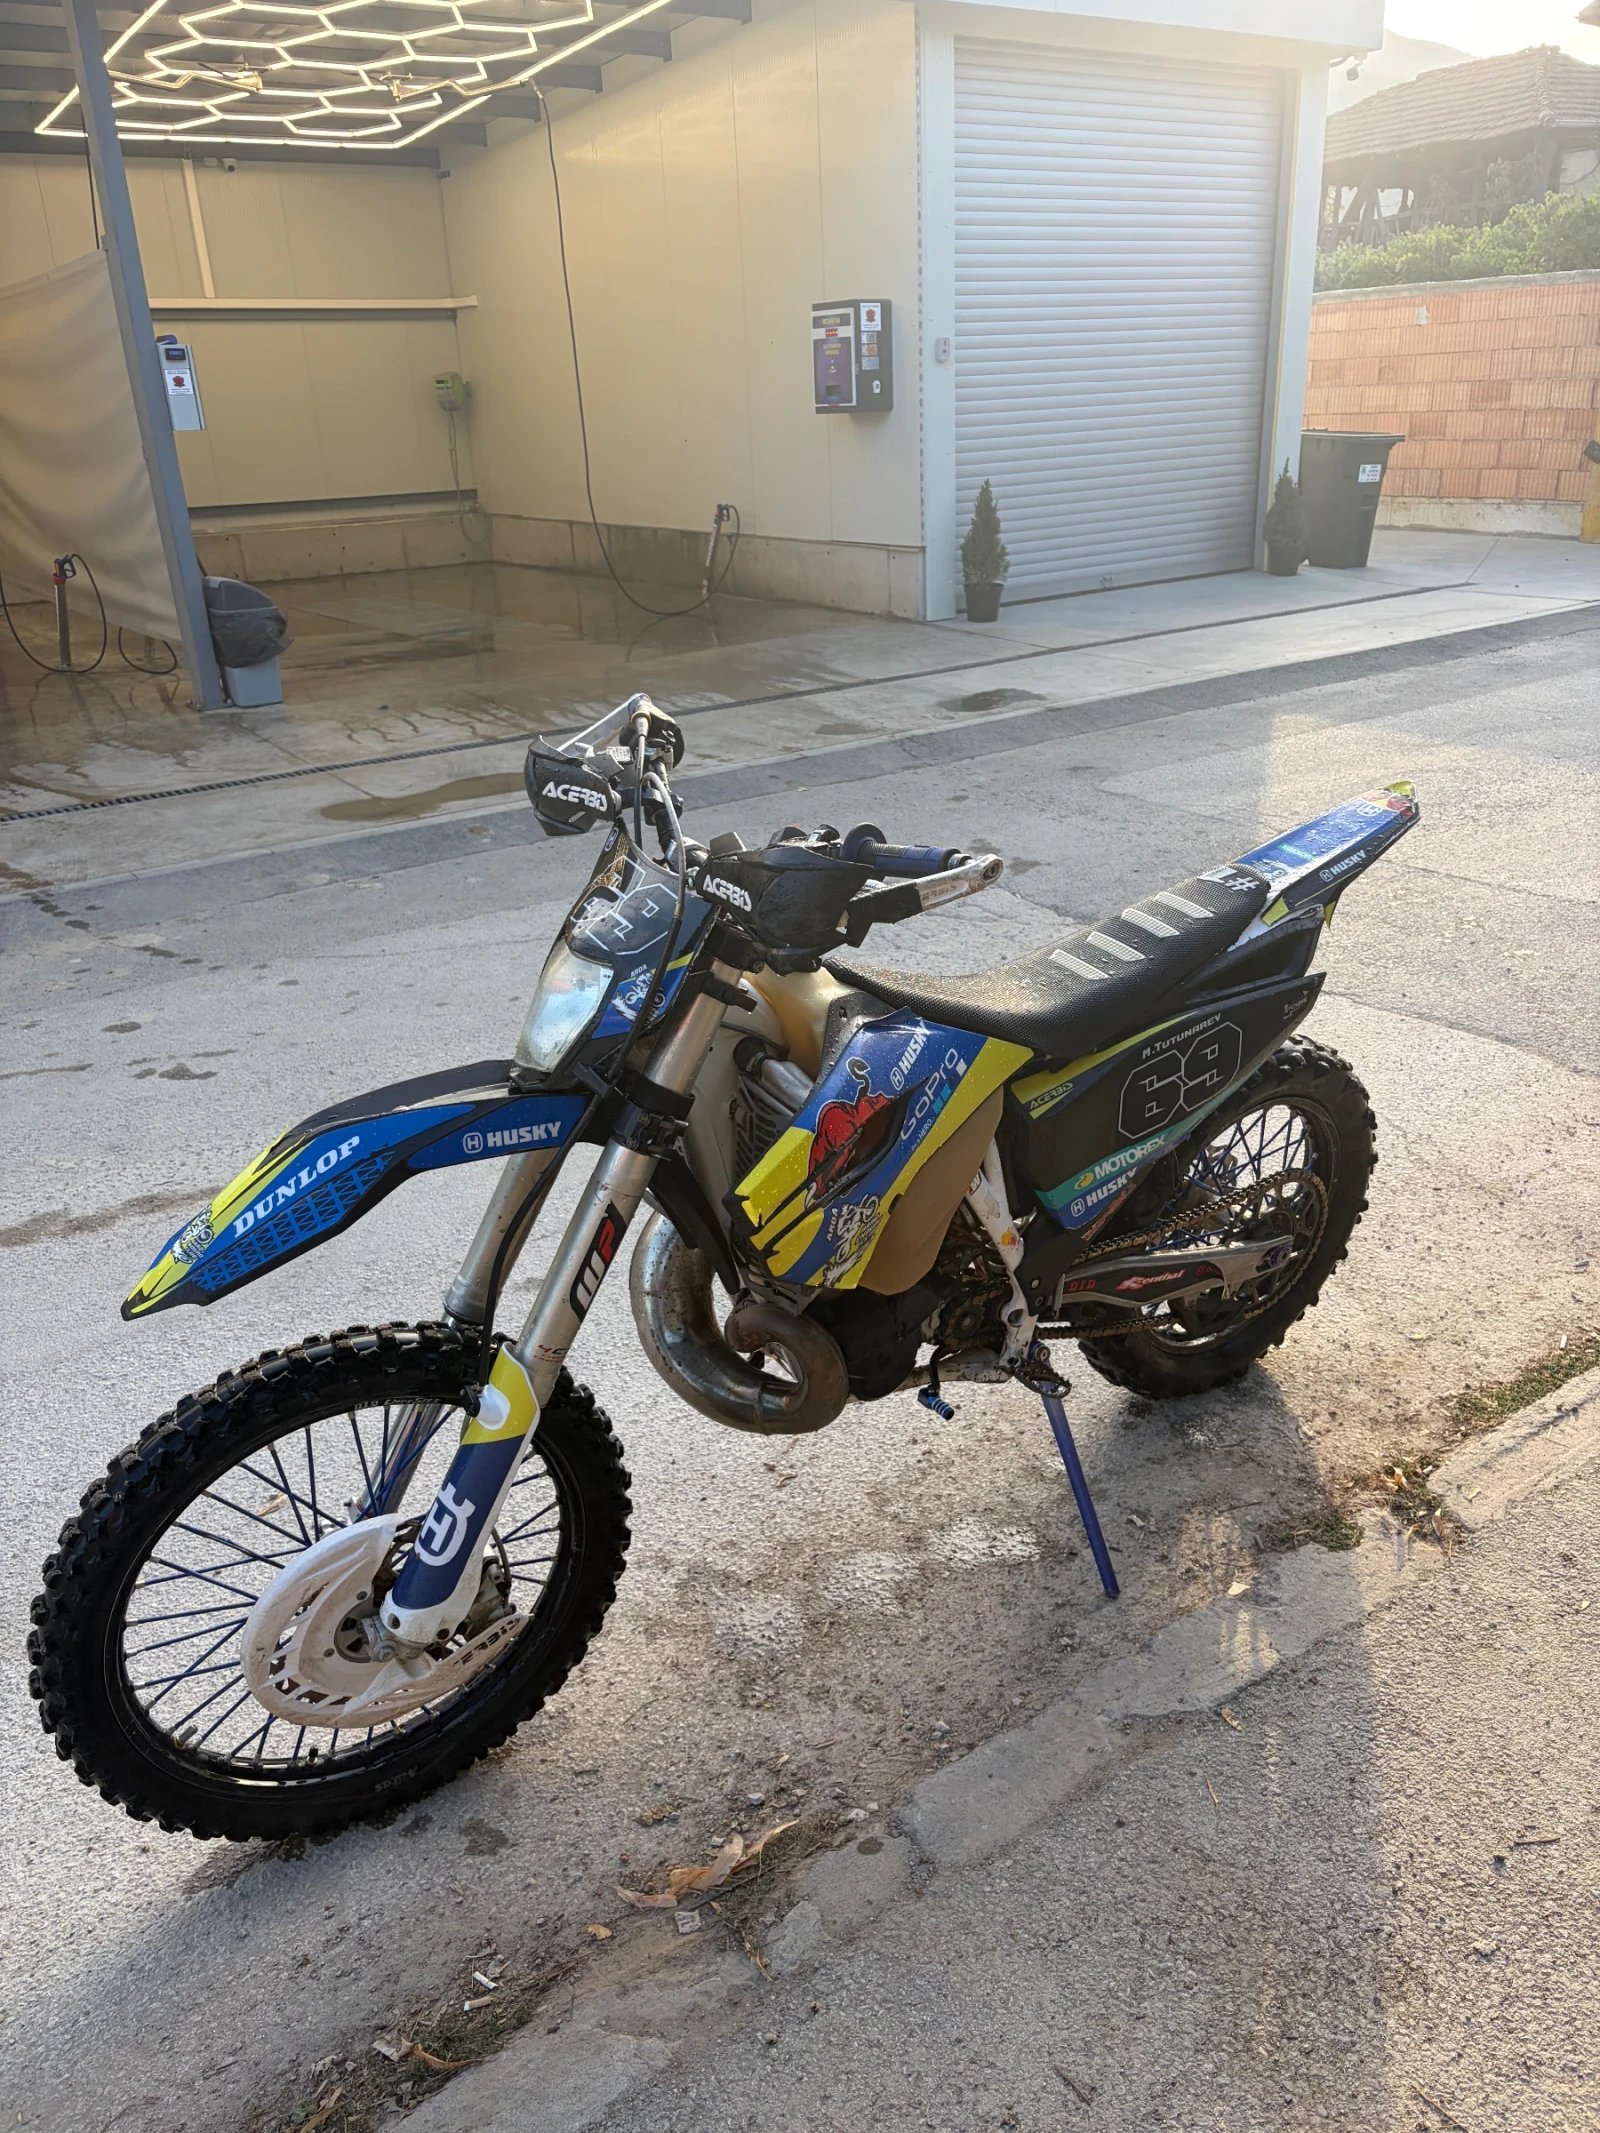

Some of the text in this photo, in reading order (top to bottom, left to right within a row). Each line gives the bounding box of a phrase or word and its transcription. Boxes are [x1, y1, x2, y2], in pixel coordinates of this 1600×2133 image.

[542, 781, 608, 812] ACERBIS
[1330, 849, 1368, 876] HUSKY
[703, 874, 752, 912] ACERBIS
[630, 963, 648, 978] ARDA
[899, 1020, 930, 1075] HUSKY
[1029, 1081, 1074, 1110] ACERBIS
[1118, 1021, 1243, 1139] 69
[486, 1121, 562, 1148] HUSKY
[1095, 1133, 1169, 1180] MOTOREX
[233, 1135, 360, 1239] DUNLOP
[826, 1207, 839, 1242] ARDA
[1068, 1279, 1097, 1292] DID
